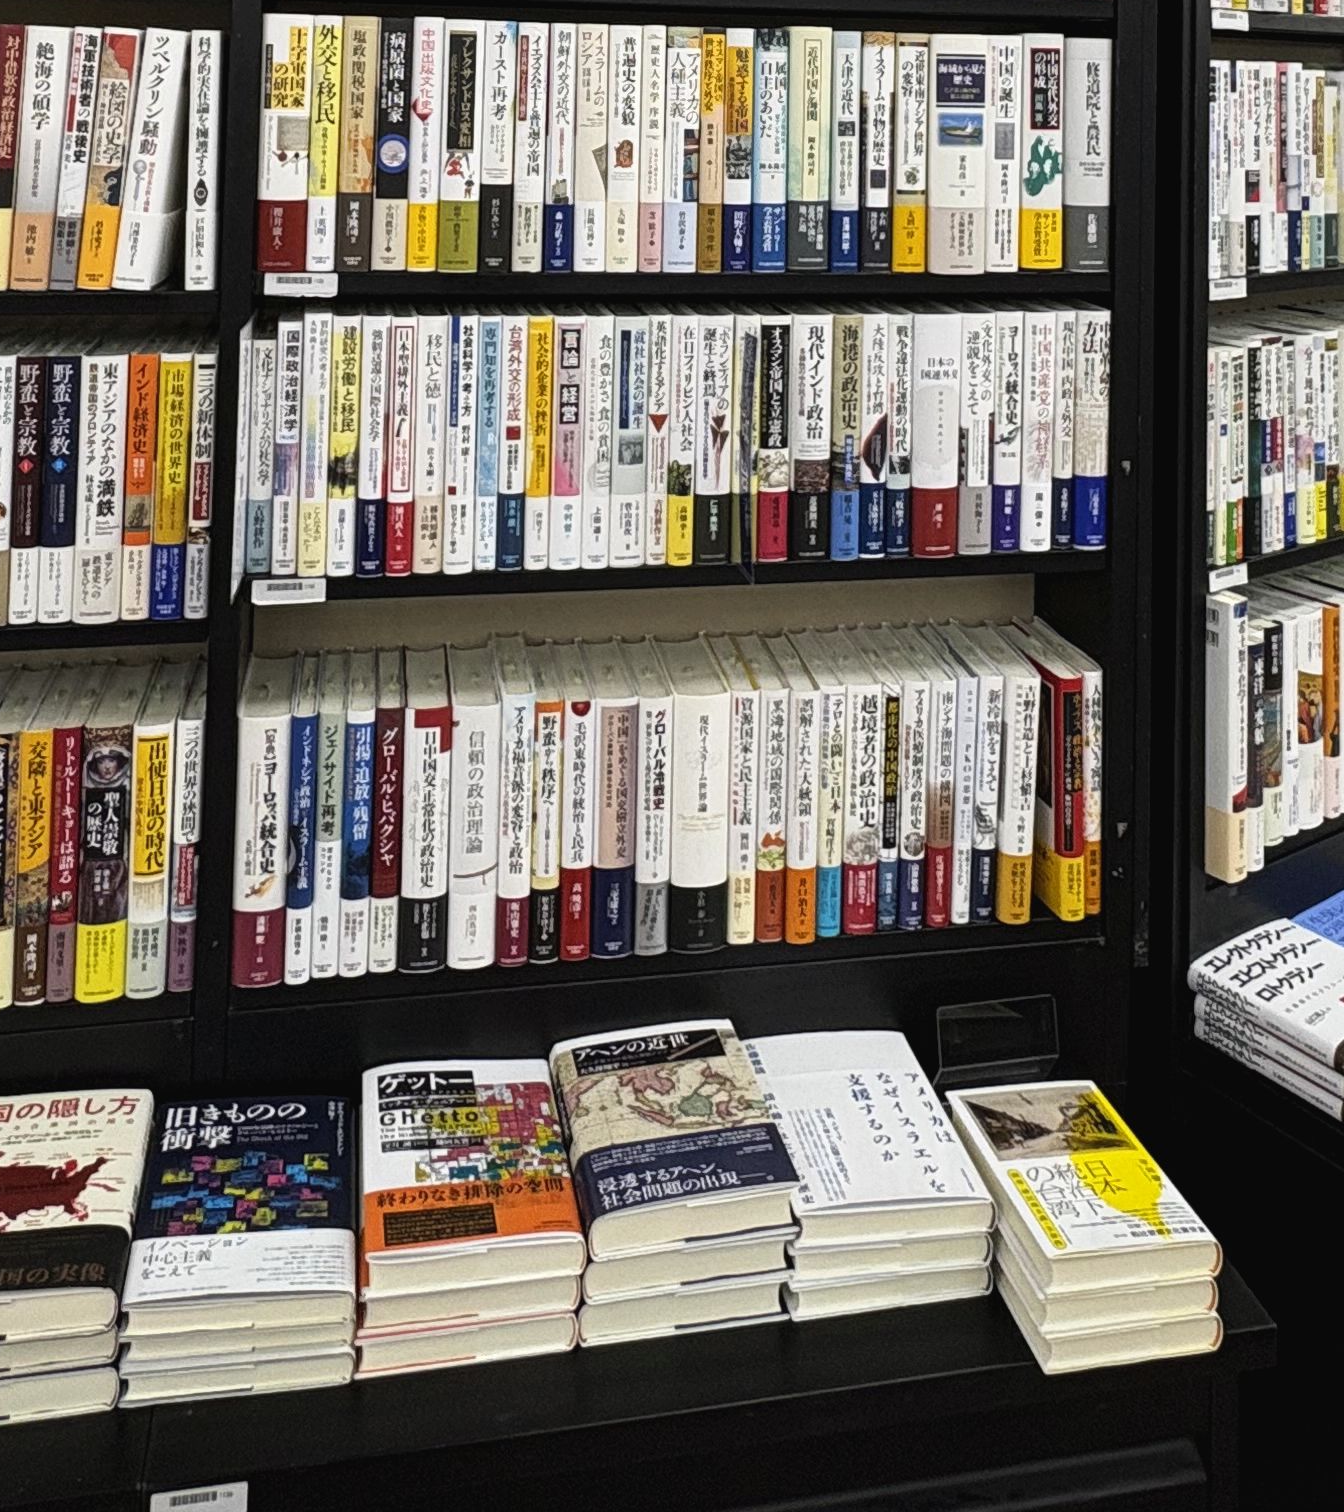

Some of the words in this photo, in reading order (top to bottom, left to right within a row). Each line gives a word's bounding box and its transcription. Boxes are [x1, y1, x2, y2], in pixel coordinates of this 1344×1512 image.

[30, 41, 56, 131] 絶海の碩学
[136, 36, 170, 157] ツベルクリン騒動
[273, 61, 288, 109] の研究
[315, 25, 337, 124] 外交と移民
[386, 32, 407, 123] 病原菌と国家
[490, 31, 507, 121] カースト再考
[685, 52, 701, 124] アメリカの
[998, 46, 1015, 118] 中国の誕生
[18, 365, 40, 456] 野蛮と宗教
[51, 365, 73, 456] 野蛮と宗教
[285, 330, 298, 432] 国際政治経済学
[339, 327, 357, 433] 建設労働と移民
[806, 325, 825, 441] 現代インド政治
[841, 325, 859, 431] 海港の政治史
[96, 484, 117, 519] 満鉄
[23, 741, 50, 858] 交隣と東アジア
[321, 724, 340, 836] ジェノサイド再考
[353, 727, 372, 842] 引揚・追放・残留
[377, 728, 399, 866] グローバル・ヒバクシャ
[464, 730, 485, 854] 信頼の政治理論
[738, 697, 754, 826] 資源国家と民主主義
[859, 694, 878, 828] 越境者の政治史
[419, 731, 437, 888] 日中国交正常化の政治史
[378, 1074, 473, 1093] ゲットー
[574, 1033, 691, 1061] アヘンの近世
[159, 1126, 234, 1150] 衝撃
[165, 1101, 307, 1127] 旧きものの
[379, 1108, 479, 1126] Ghetto
[846, 1072, 900, 1163] 支援するのか
[875, 1072, 947, 1194] なぜイスラエルを
[903, 1072, 957, 1144] アメリカは
[376, 1179, 565, 1206] 終わりなき排除の空間
[600, 1172, 743, 1209] 社会問題の出現
[1087, 1160, 1128, 1194] 日本
[140, 1264, 196, 1280] をこえて
[144, 1235, 249, 1252] イノベーション
